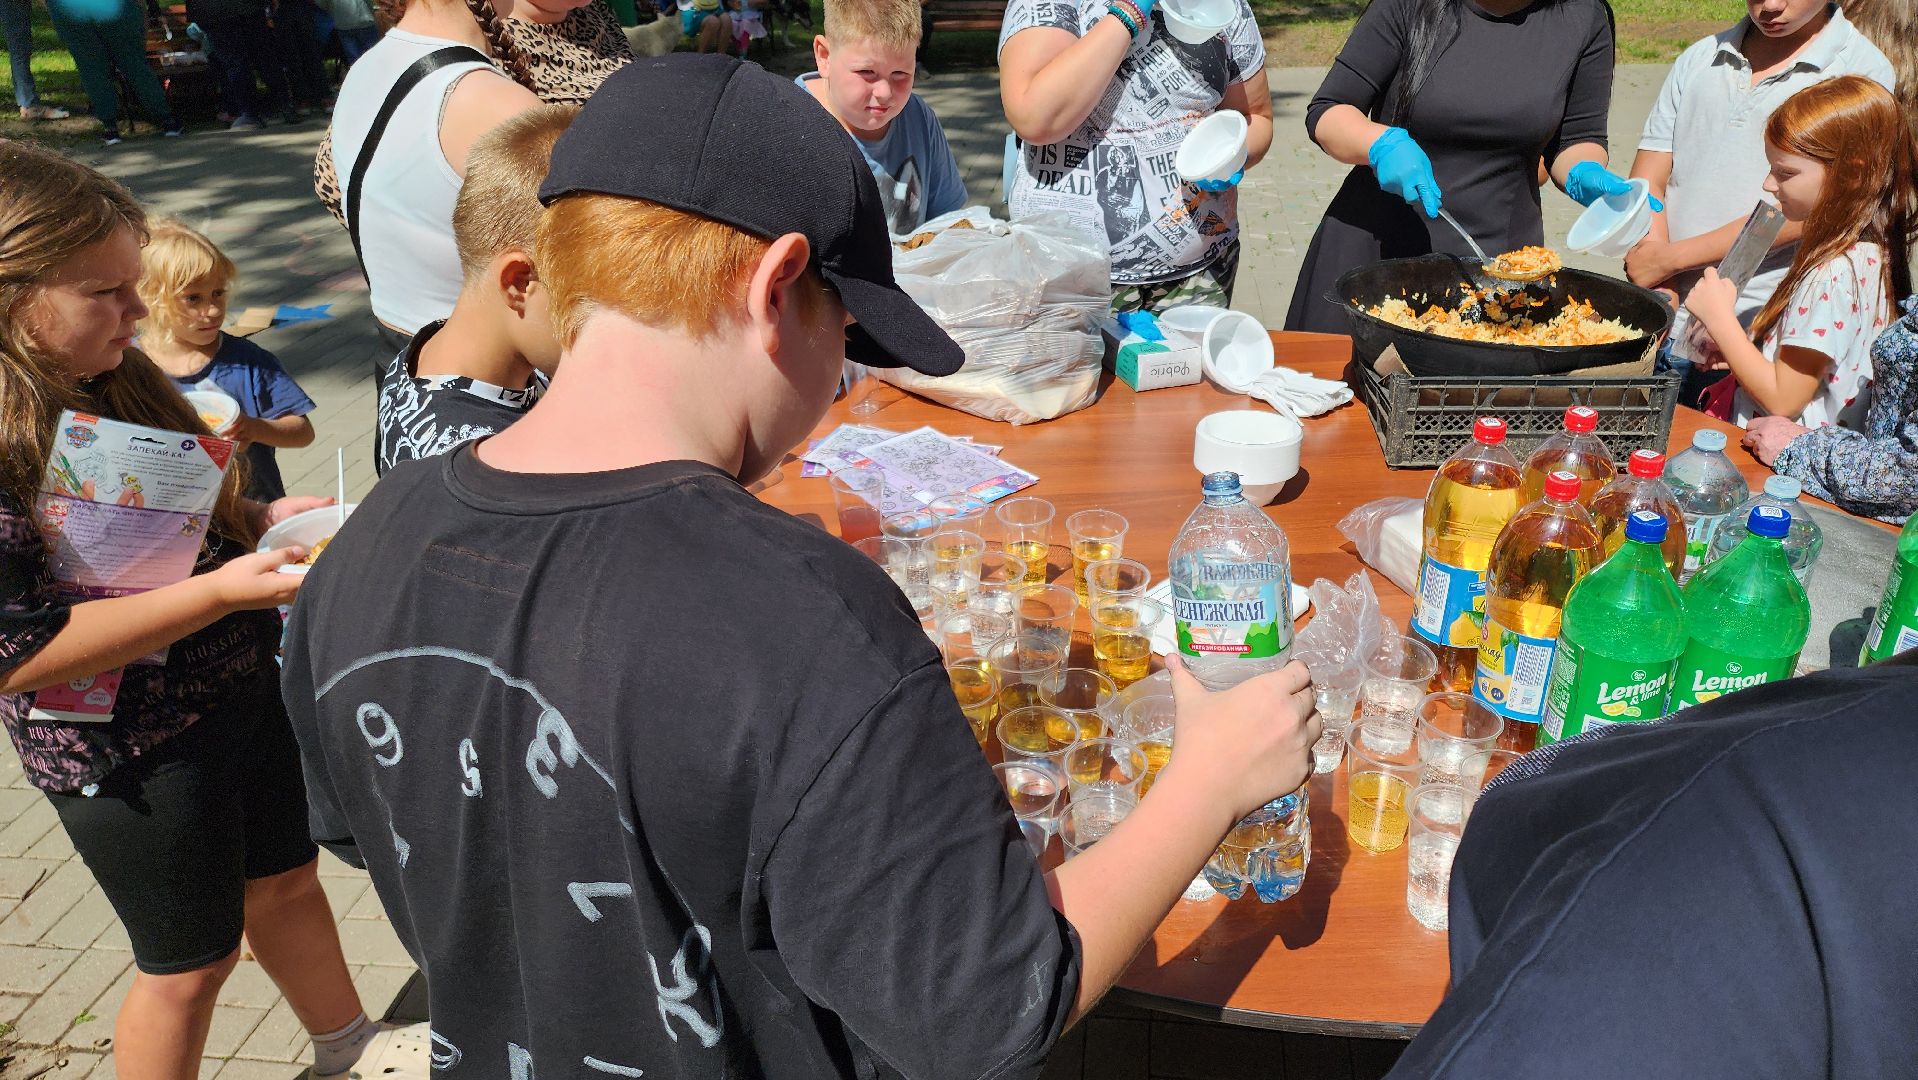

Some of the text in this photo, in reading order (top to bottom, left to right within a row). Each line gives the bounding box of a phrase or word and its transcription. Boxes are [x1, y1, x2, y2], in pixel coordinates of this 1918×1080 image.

[1040, 143, 1057, 165] IS
[1034, 169, 1091, 196] DEAD
[1174, 600, 1265, 621] СЕНЕЖСКАЯ
[1191, 644, 1248, 652] НЕГАЗИРОВАННАЯ
[1596, 672, 1667, 705] Lemon
[1692, 669, 1768, 692] Lemon
[1641, 687, 1661, 702] lime
